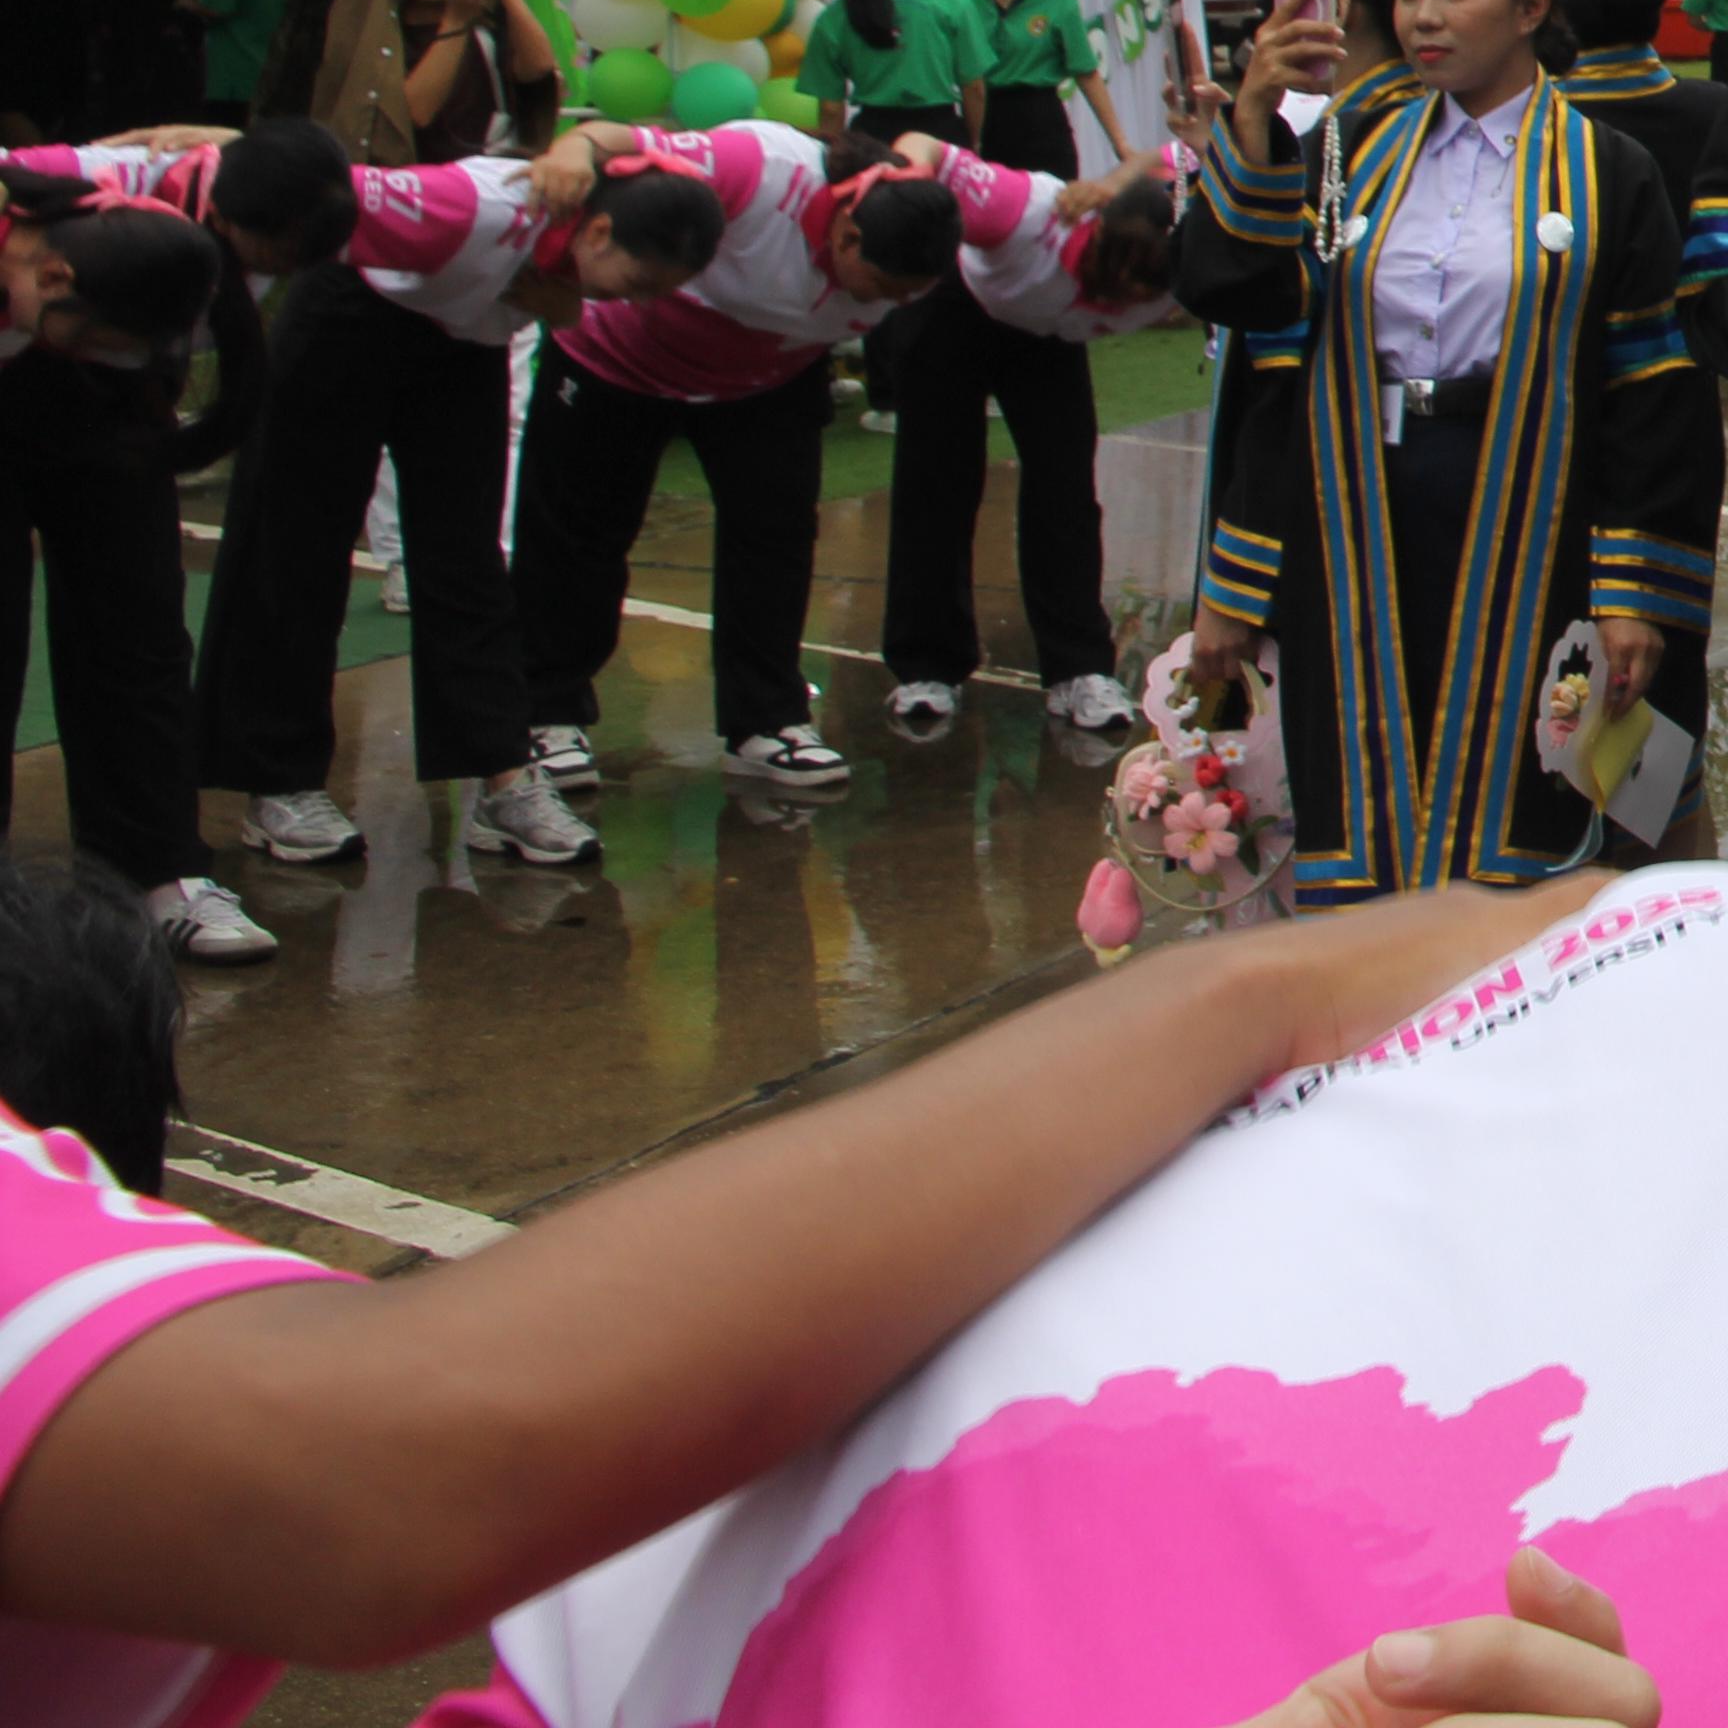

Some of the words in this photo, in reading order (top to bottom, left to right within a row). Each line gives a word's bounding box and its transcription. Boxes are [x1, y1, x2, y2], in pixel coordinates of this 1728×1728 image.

[386, 169, 424, 223] 67
[966, 161, 996, 208] 67
[1451, 906, 1726, 1052] UNIVERSITY
